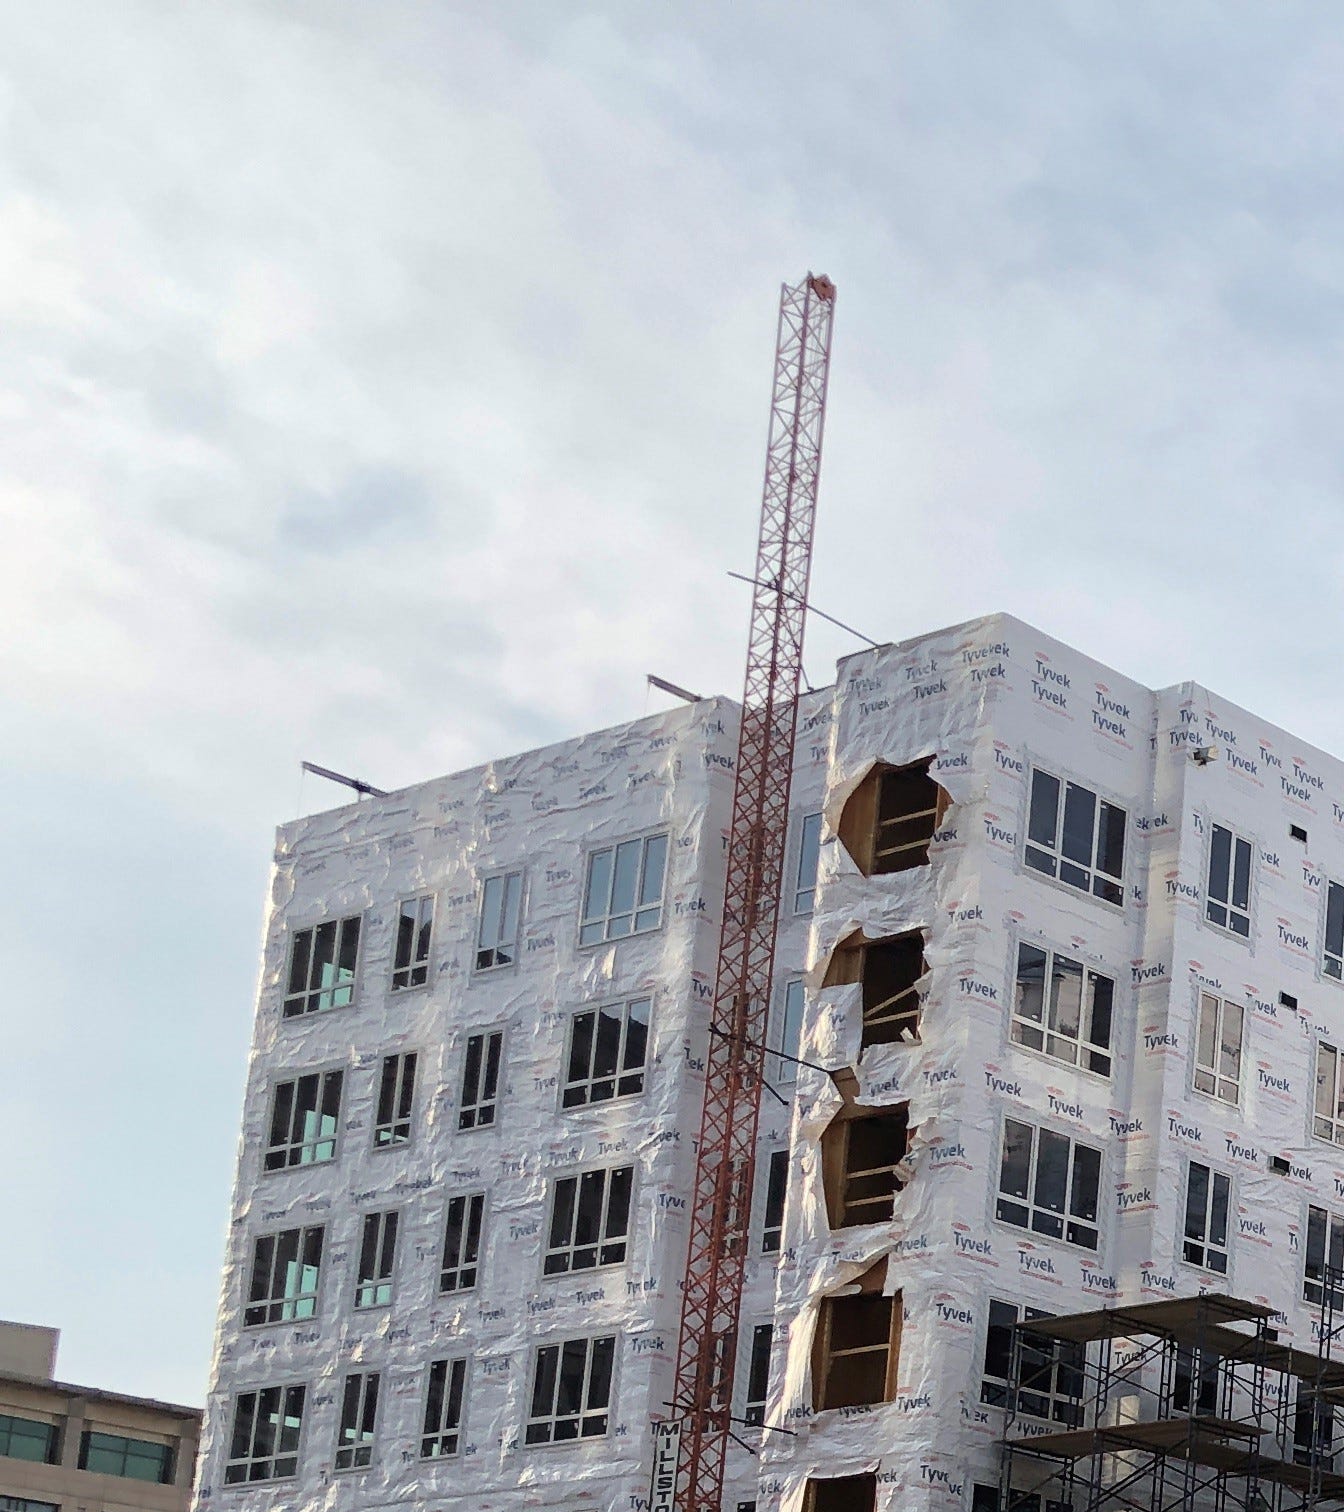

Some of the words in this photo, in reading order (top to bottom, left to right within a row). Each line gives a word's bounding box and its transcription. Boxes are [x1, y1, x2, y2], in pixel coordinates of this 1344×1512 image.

[1096, 691, 1129, 719] Tyvek
[1170, 730, 1202, 746] Tyvek
[1226, 748, 1257, 775] Tyvek
[1278, 925, 1308, 950] Tyvek
[960, 978, 997, 999] Tyvek
[985, 1072, 1021, 1097] Tyvek
[1048, 1095, 1083, 1119] Tyvek
[1225, 1139, 1257, 1162] Tyvek
[954, 1231, 991, 1260] Tyvek
[1018, 1250, 1055, 1278] Tyvek
[1081, 1269, 1117, 1294] Tyvek
[1141, 1271, 1175, 1295] Tyvek
[936, 1303, 972, 1324] Tyvek
